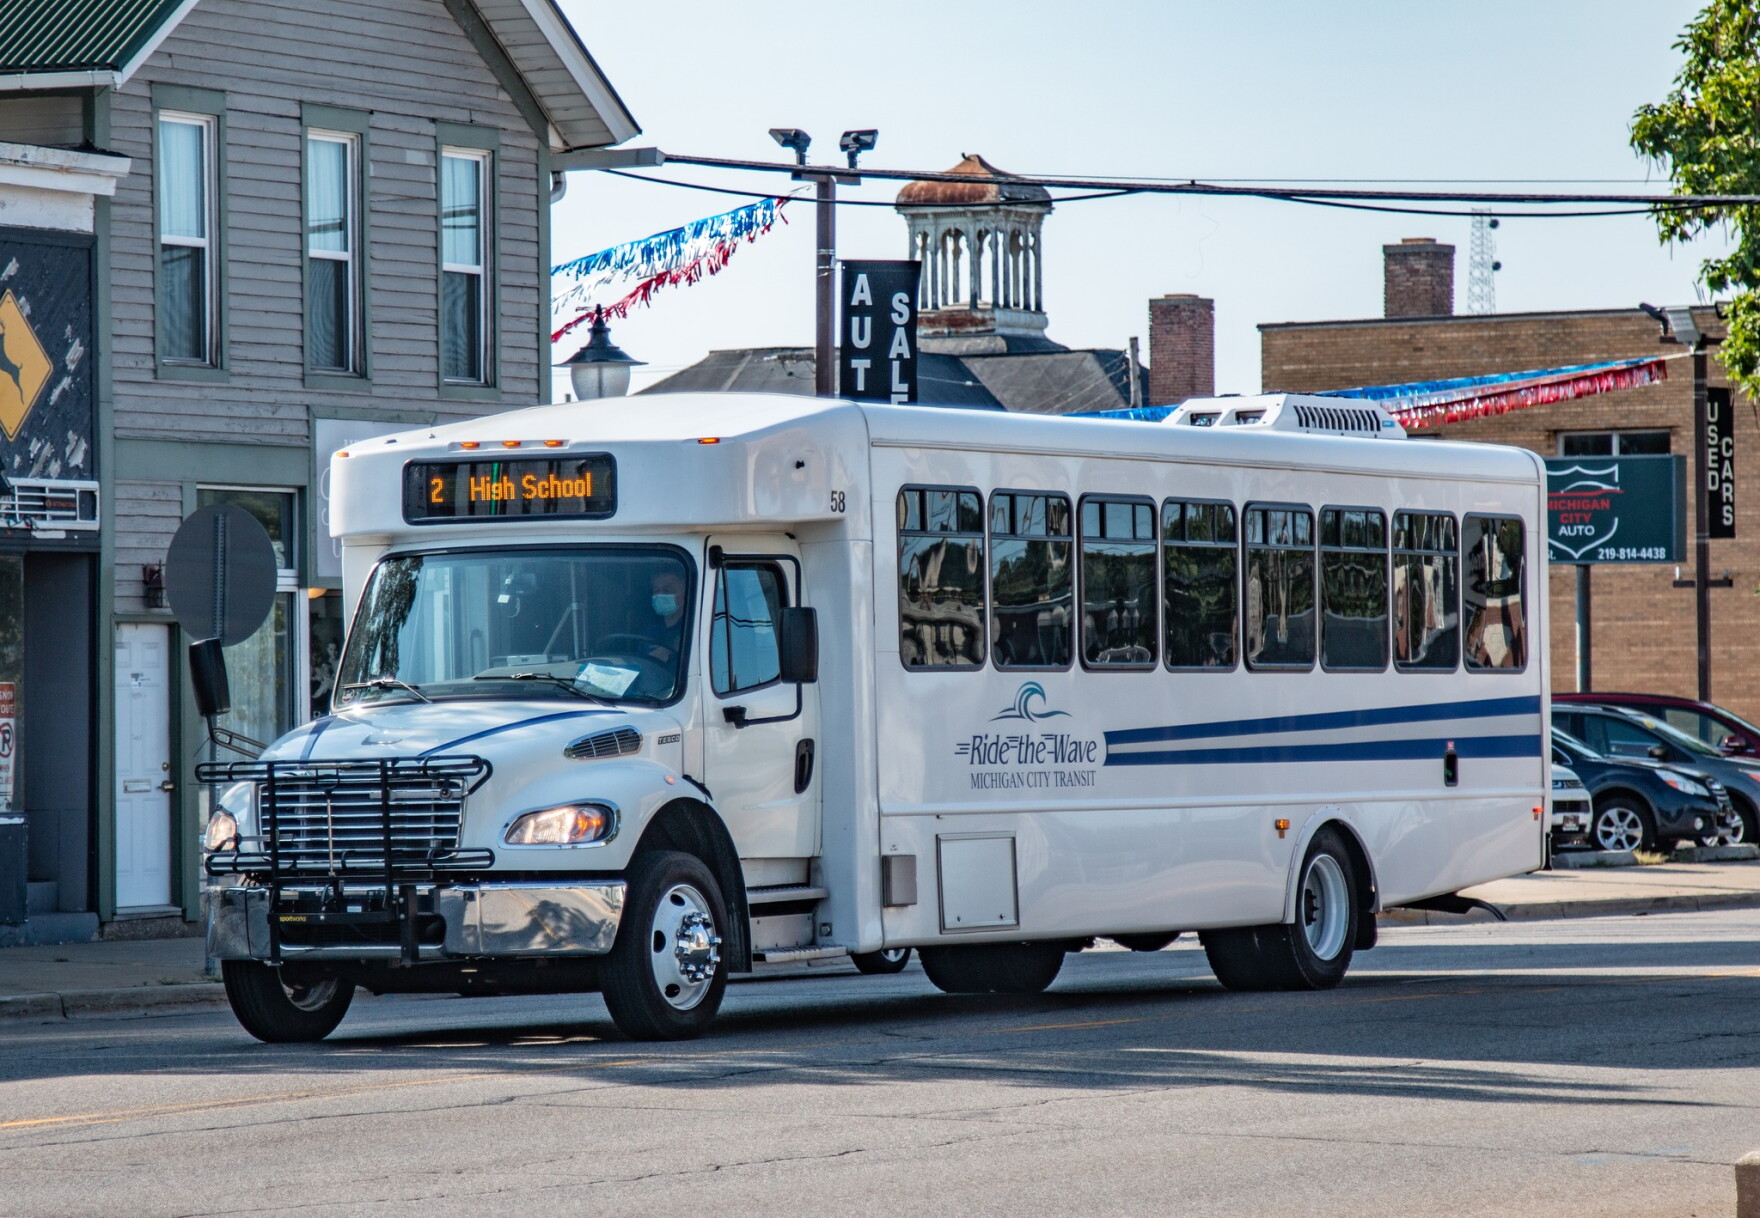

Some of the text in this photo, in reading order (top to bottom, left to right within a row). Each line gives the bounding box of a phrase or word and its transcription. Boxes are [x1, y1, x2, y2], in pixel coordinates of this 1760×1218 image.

[851, 274, 873, 391] AUT
[1707, 402, 1719, 491] USED
[430, 472, 593, 503] 2 High School
[1721, 437, 1734, 526] CARS
[830, 490, 846, 513] 58
[1558, 525, 1595, 536] AUTO
[1560, 512, 1592, 524] CITY
[1598, 547, 1666, 560] 219-814-4438
[970, 733, 1097, 765] Ride the Wave
[970, 770, 1096, 789] MICHIGAN CITY TRANSIT
